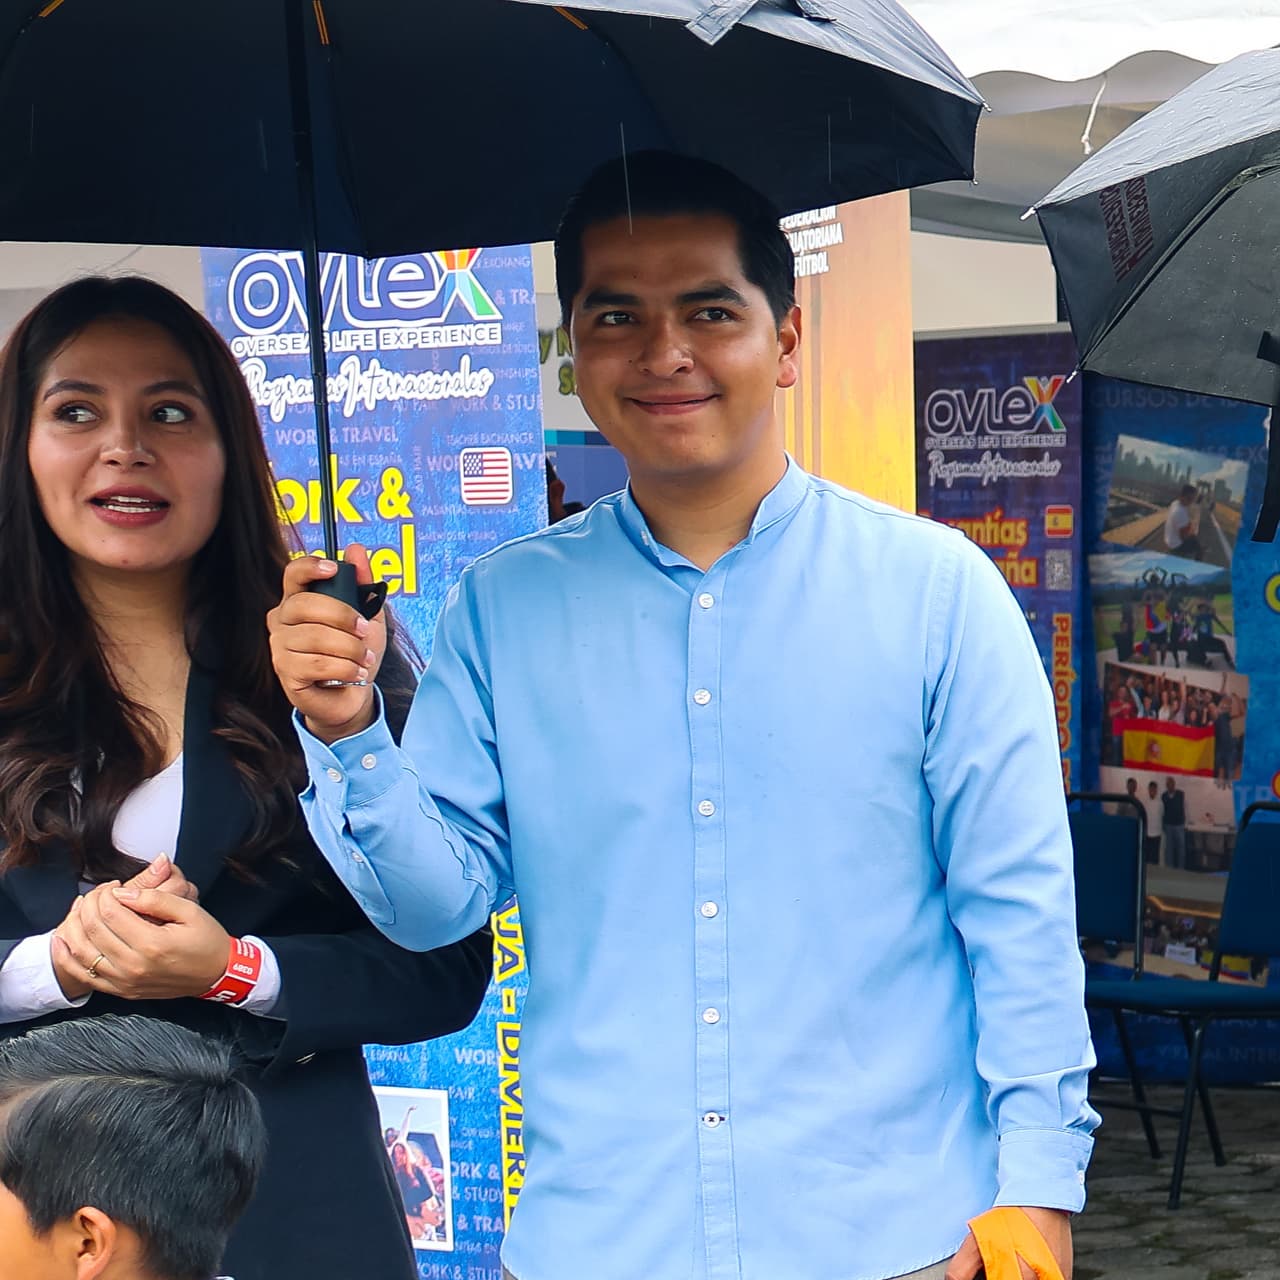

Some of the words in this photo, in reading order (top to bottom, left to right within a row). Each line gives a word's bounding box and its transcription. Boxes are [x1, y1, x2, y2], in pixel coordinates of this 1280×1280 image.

[333, 334, 375, 350] LIFE
[382, 324, 501, 348] EXPERIENCE
[275, 428, 318, 446] WOR
[342, 425, 398, 443] TRAVEL
[269, 453, 364, 524] ork
[376, 467, 414, 520] &
[488, 1163, 501, 1180] &
[457, 1215, 469, 1231] &
[453, 1265, 464, 1280] &
